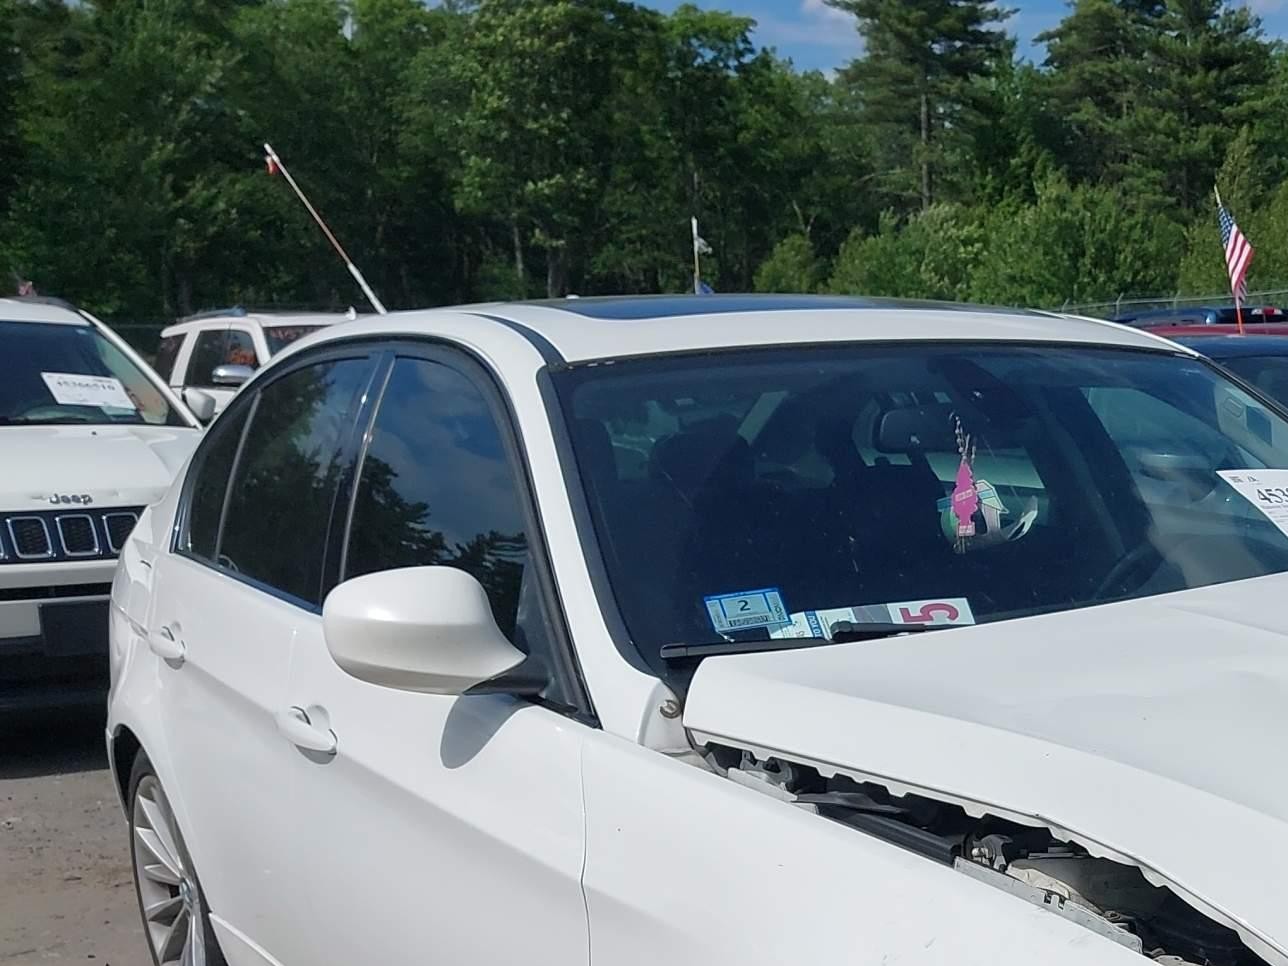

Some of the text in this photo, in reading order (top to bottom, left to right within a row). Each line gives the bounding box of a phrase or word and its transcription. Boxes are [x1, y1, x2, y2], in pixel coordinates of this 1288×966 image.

[50, 493, 93, 506] Jeep
[737, 599, 751, 612] 2
[898, 602, 959, 624] 5
